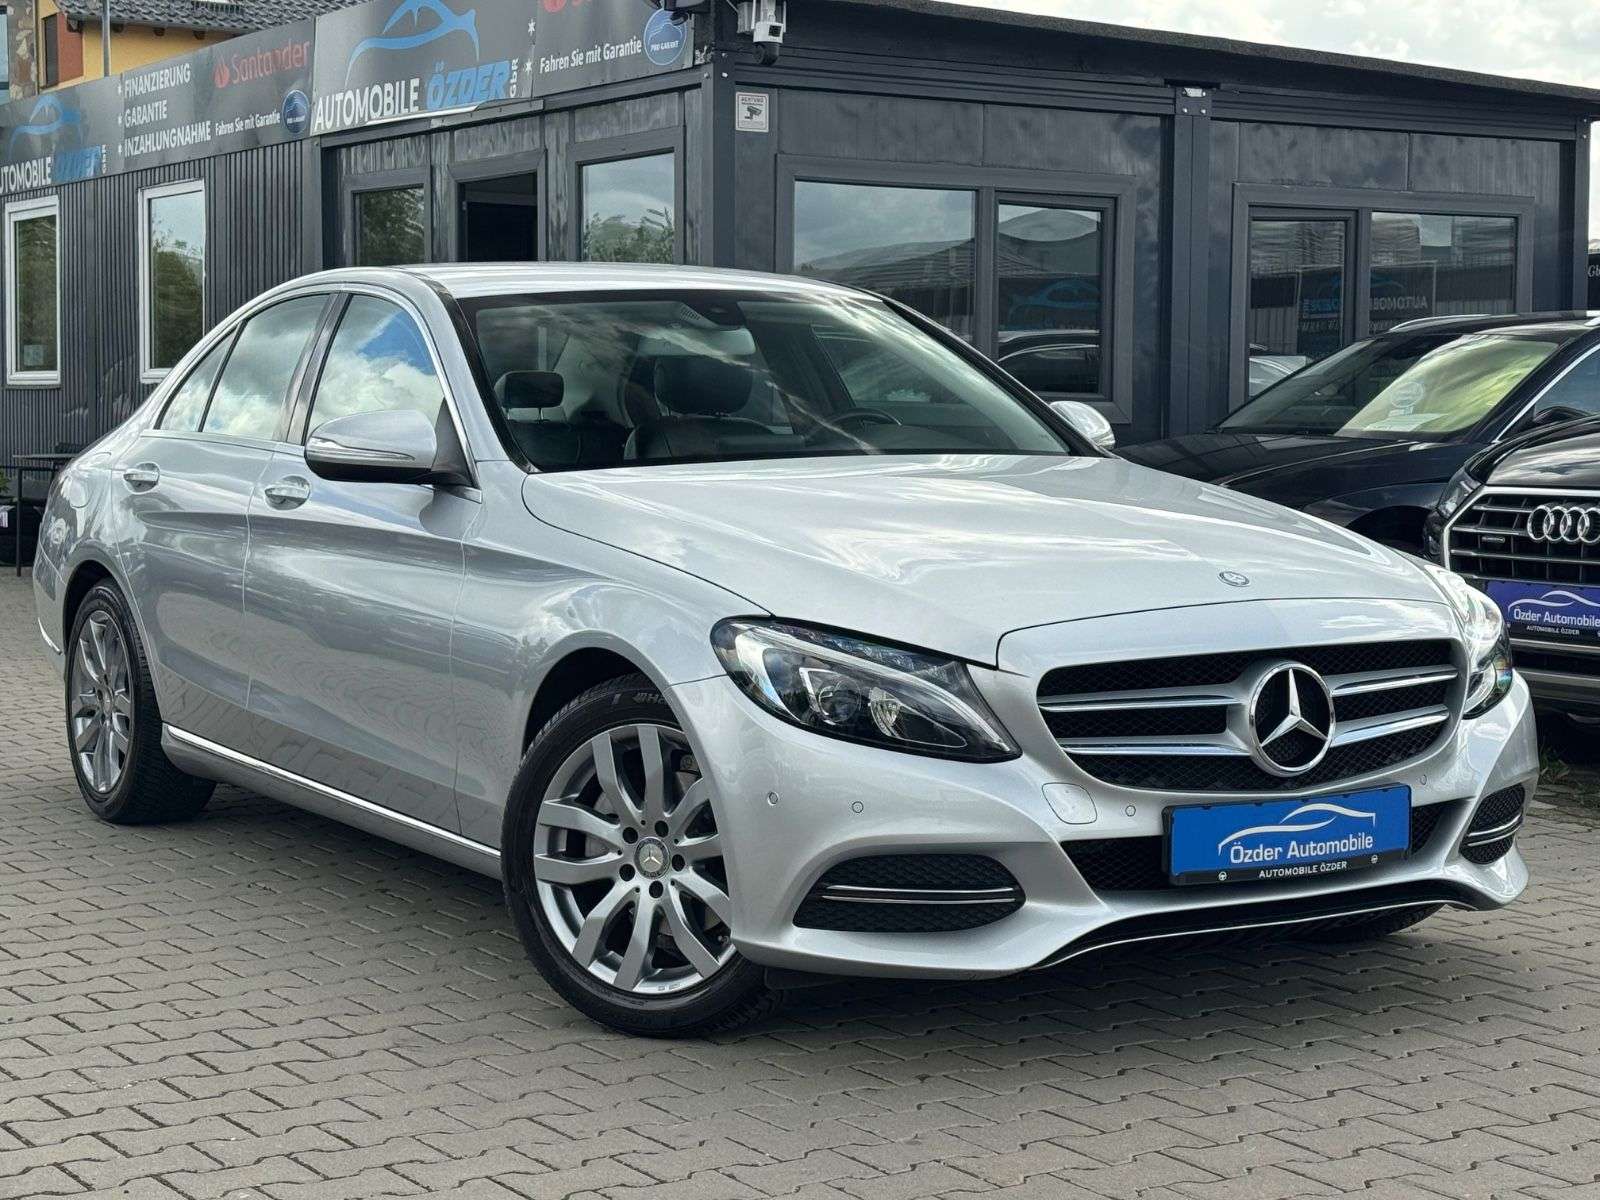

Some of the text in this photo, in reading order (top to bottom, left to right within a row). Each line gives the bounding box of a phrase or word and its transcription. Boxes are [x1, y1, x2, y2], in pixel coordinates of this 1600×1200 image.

[231, 38, 310, 84] Santander
[539, 35, 642, 74] Fahren Sie mit Garantie
[124, 63, 191, 98] FINANZIERUNG
[510, 57, 519, 98] GbR
[314, 60, 512, 131] AUTOMOBILE ÖZDER
[124, 100, 167, 128] GARANTIE
[215, 119, 234, 136] Fahren
[235, 116, 244, 132] Sie
[244, 113, 255, 130] mit
[255, 108, 281, 128] Garantie
[124, 120, 212, 157] INZAHLUNGNAHME
[1513, 606, 1600, 627] Özder Automobile
[1230, 832, 1374, 864] Özder Automobile
[1259, 861, 1348, 879] AUTOMOBILE ÖZDER
